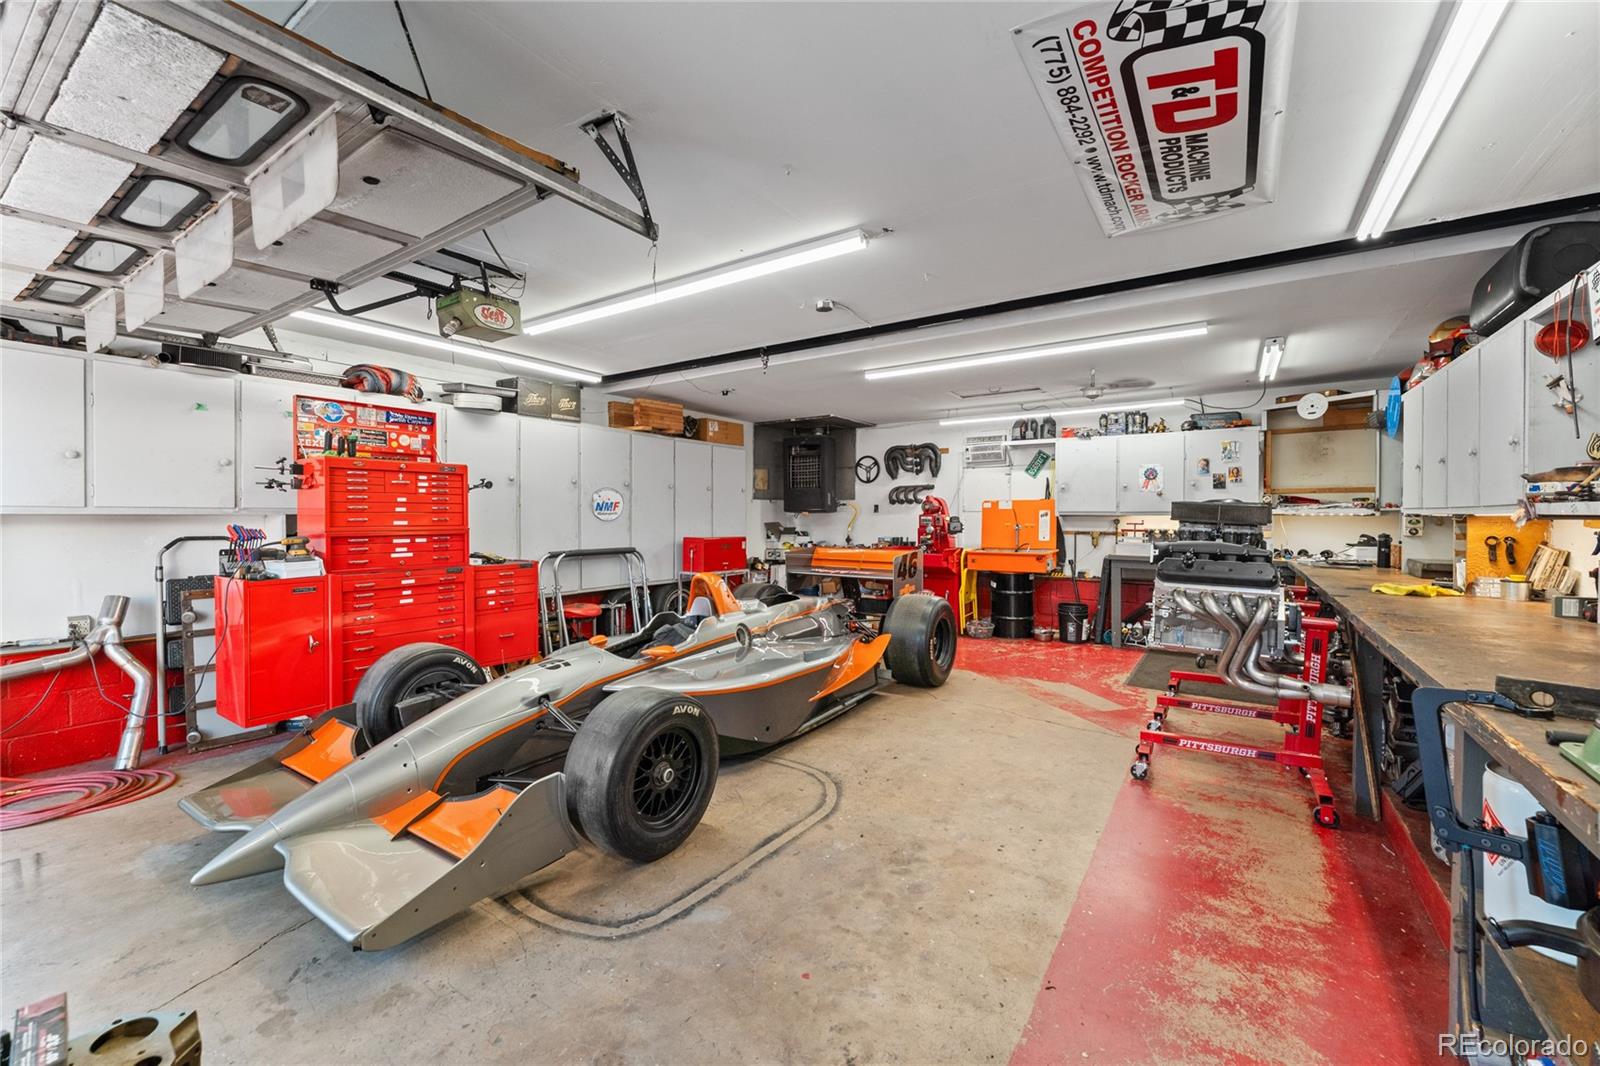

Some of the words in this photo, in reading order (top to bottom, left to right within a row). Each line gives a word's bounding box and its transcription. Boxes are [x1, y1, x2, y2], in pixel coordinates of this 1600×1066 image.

[1032, 36, 1069, 85] (775)
[1056, 86, 1097, 146] 884-2292
[1146, 47, 1238, 134] T&D
[1073, 18, 1128, 153] COMPETITION
[1114, 152, 1144, 202] ROCKER
[1158, 138, 1189, 194] PRODUCTS
[1184, 133, 1211, 183] MACHINE
[595, 500, 620, 512] NMF
[897, 551, 918, 581] 46
[452, 656, 478, 674] AVON
[672, 704, 701, 717] AVON
[1190, 702, 1258, 718] PITTSBURGH
[1178, 737, 1258, 758] PITTSBURGH
